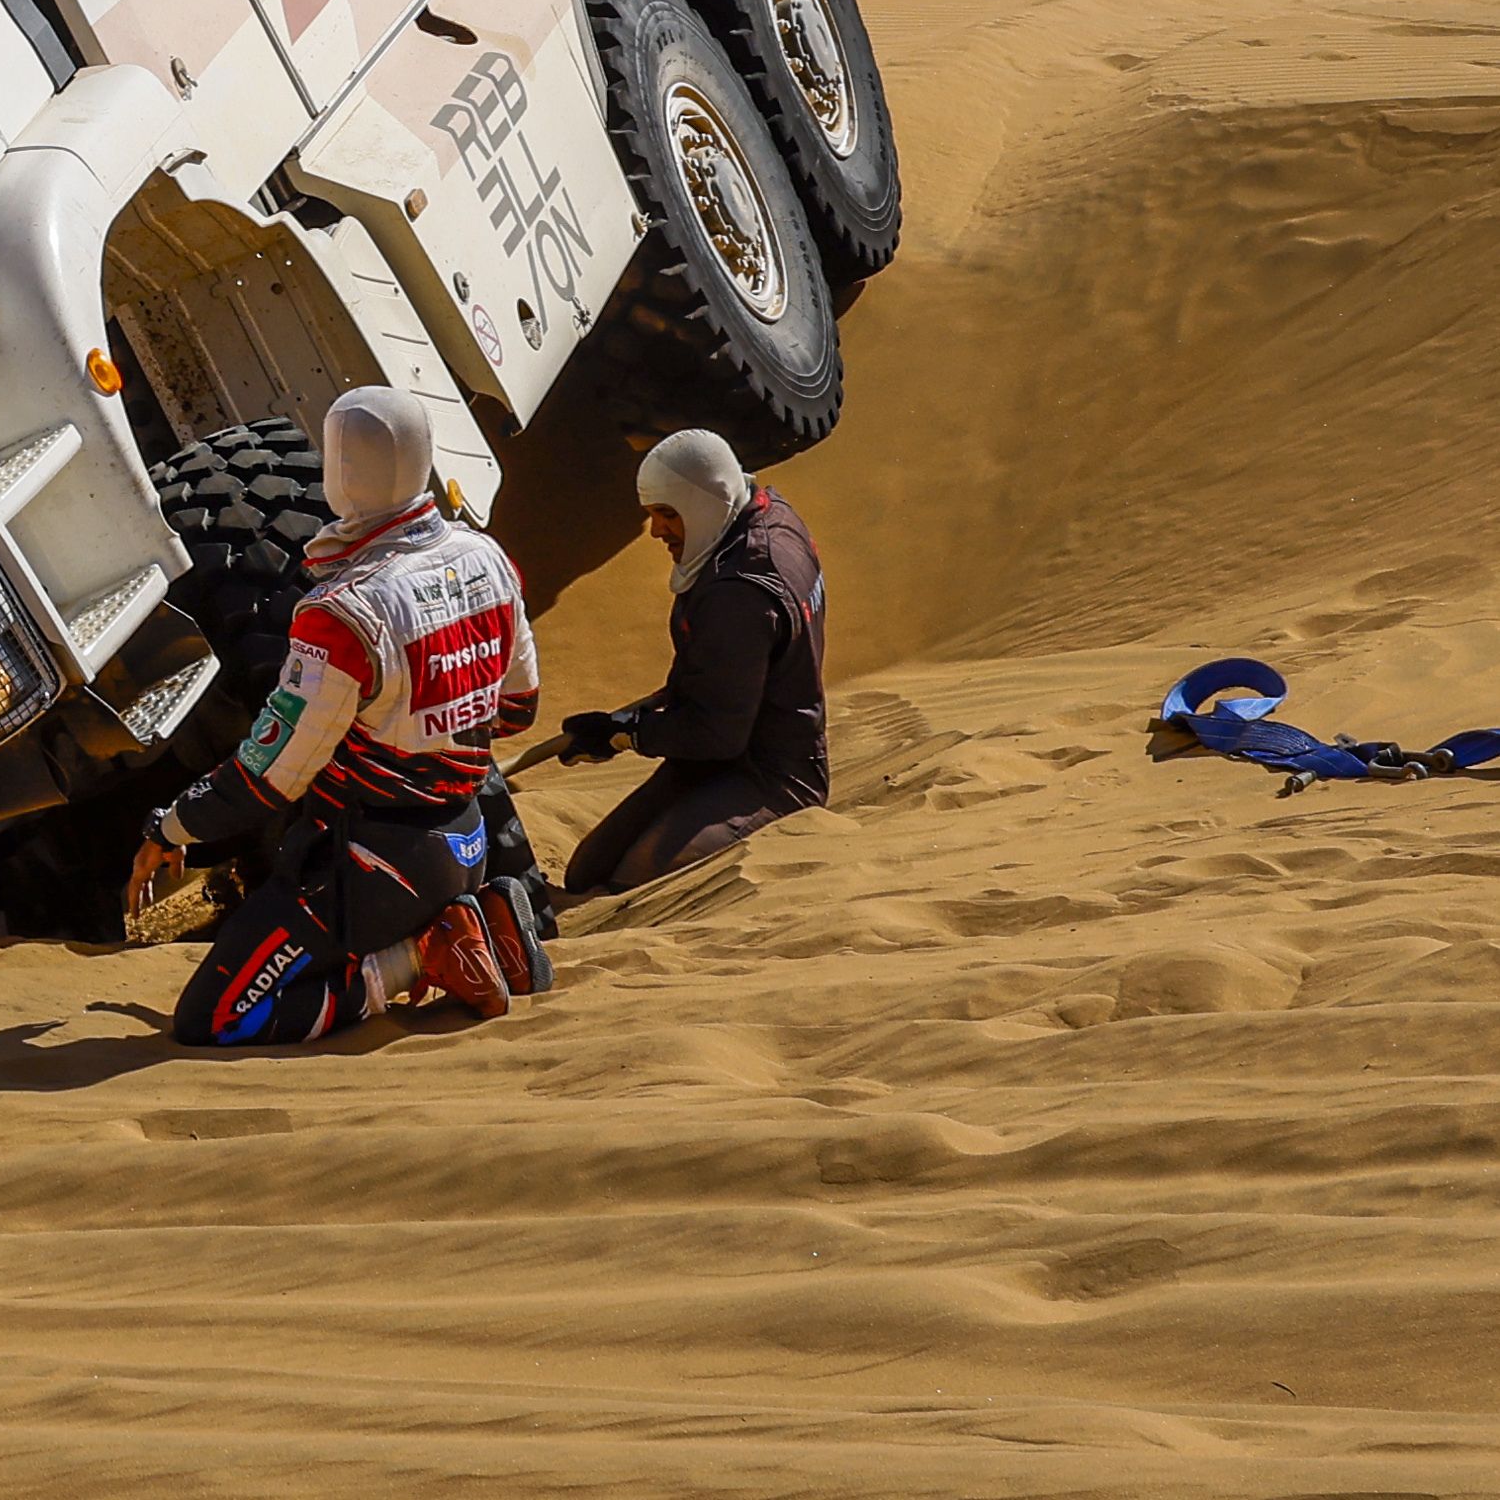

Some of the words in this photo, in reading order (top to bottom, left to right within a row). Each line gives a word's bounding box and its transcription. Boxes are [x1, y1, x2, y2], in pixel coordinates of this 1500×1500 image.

[292, 641, 326, 661] SSAN
[428, 635, 502, 680] Fireston
[423, 688, 499, 736] NISSA
[236, 943, 304, 1013] RADIAL
